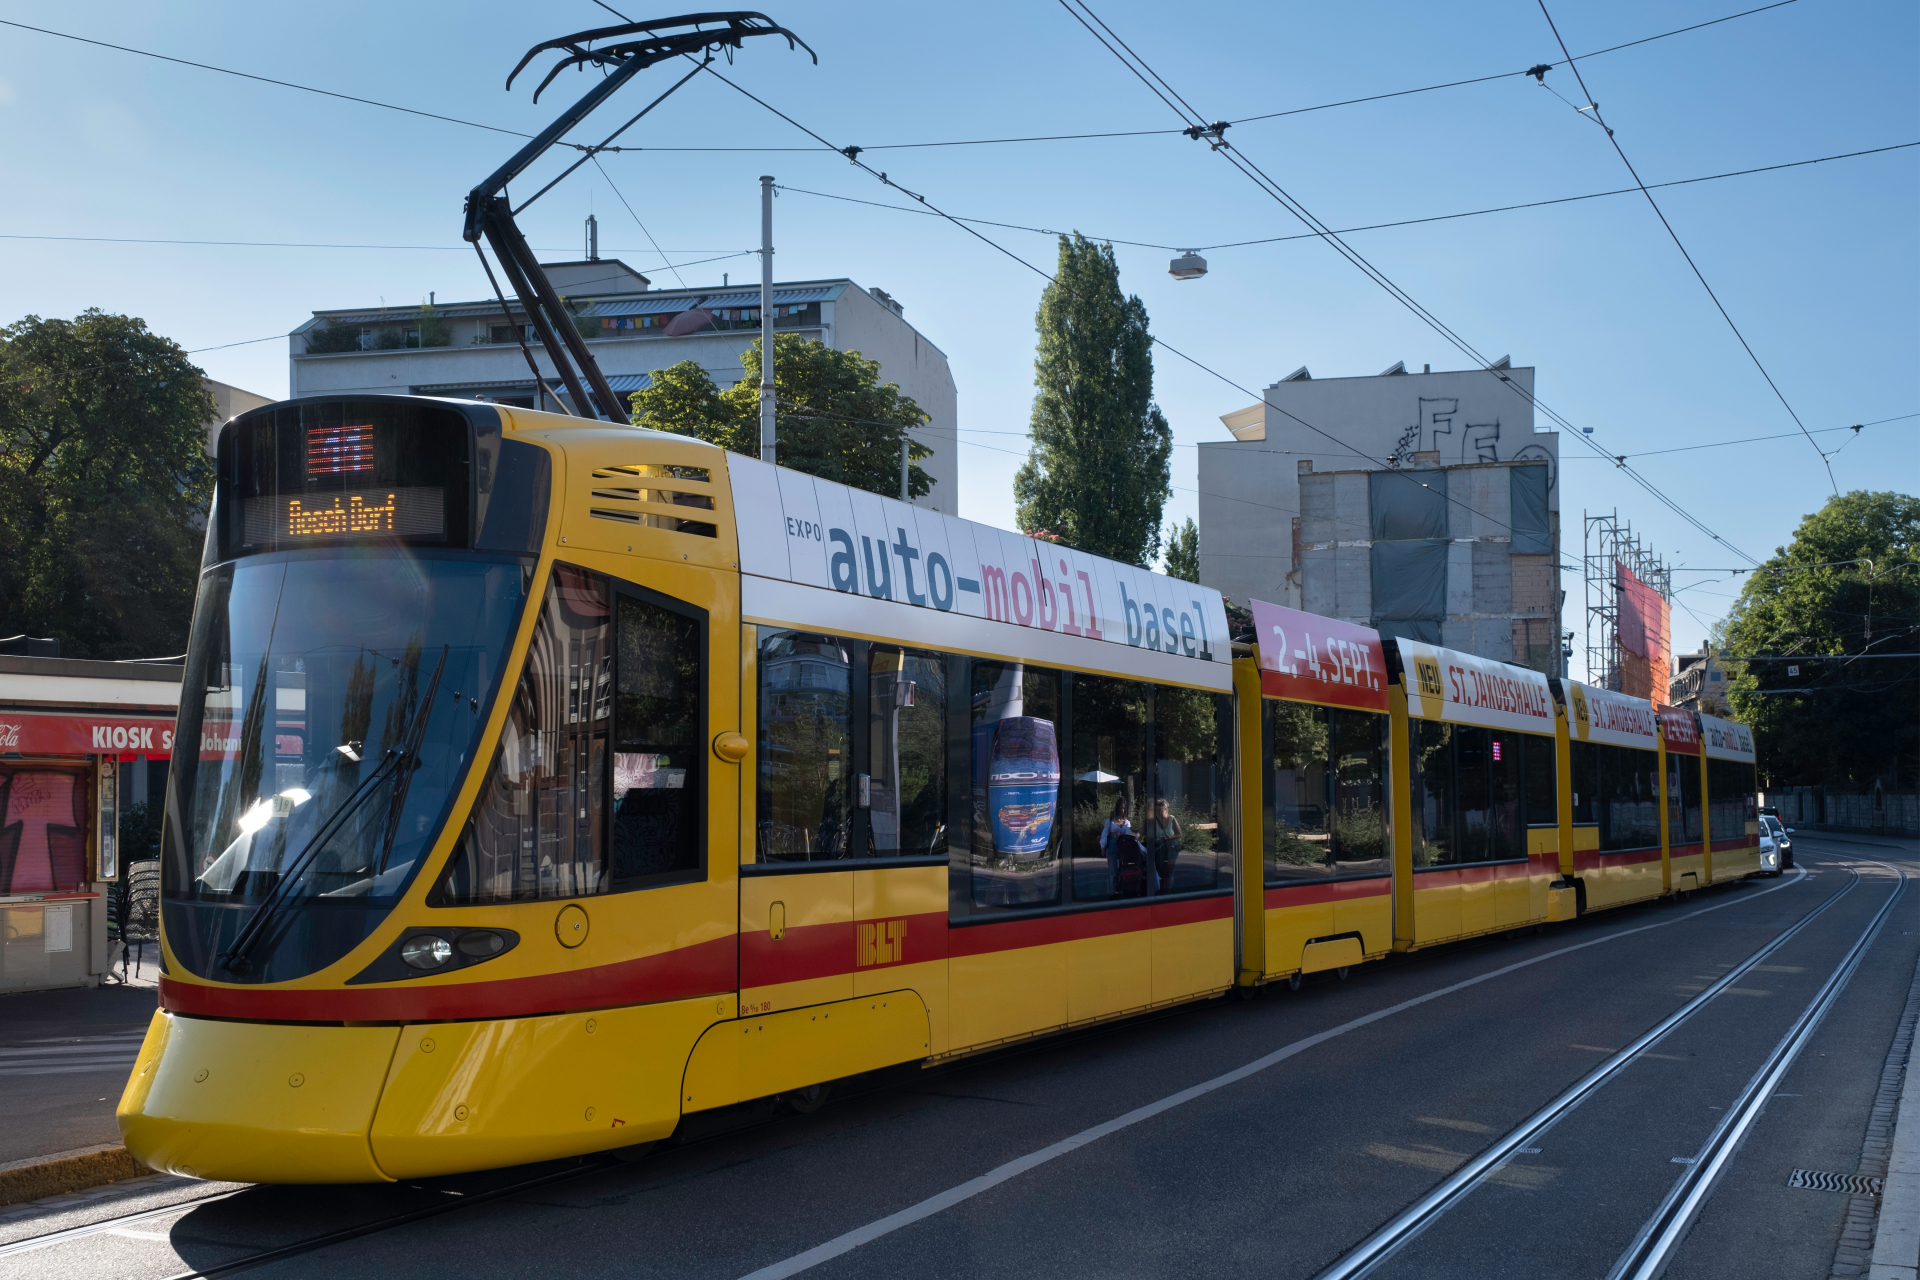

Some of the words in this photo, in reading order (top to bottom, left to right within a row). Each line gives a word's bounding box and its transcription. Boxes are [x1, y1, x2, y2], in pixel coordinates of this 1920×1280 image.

[289, 497, 346, 535] Aesch
[350, 493, 396, 531] Dorf
[785, 516, 822, 544] EXPO
[827, 526, 1104, 640] auto-mobil
[1118, 581, 1213, 662] basel
[1418, 662, 1441, 695] NEU
[1789, 666, 1798, 675] 45
[92, 725, 154, 749] KIOSK
[161, 730, 175, 751] S
[856, 919, 908, 968] BLT
[741, 1004, 749, 1015] Be
[760, 1001, 771, 1012] 180
